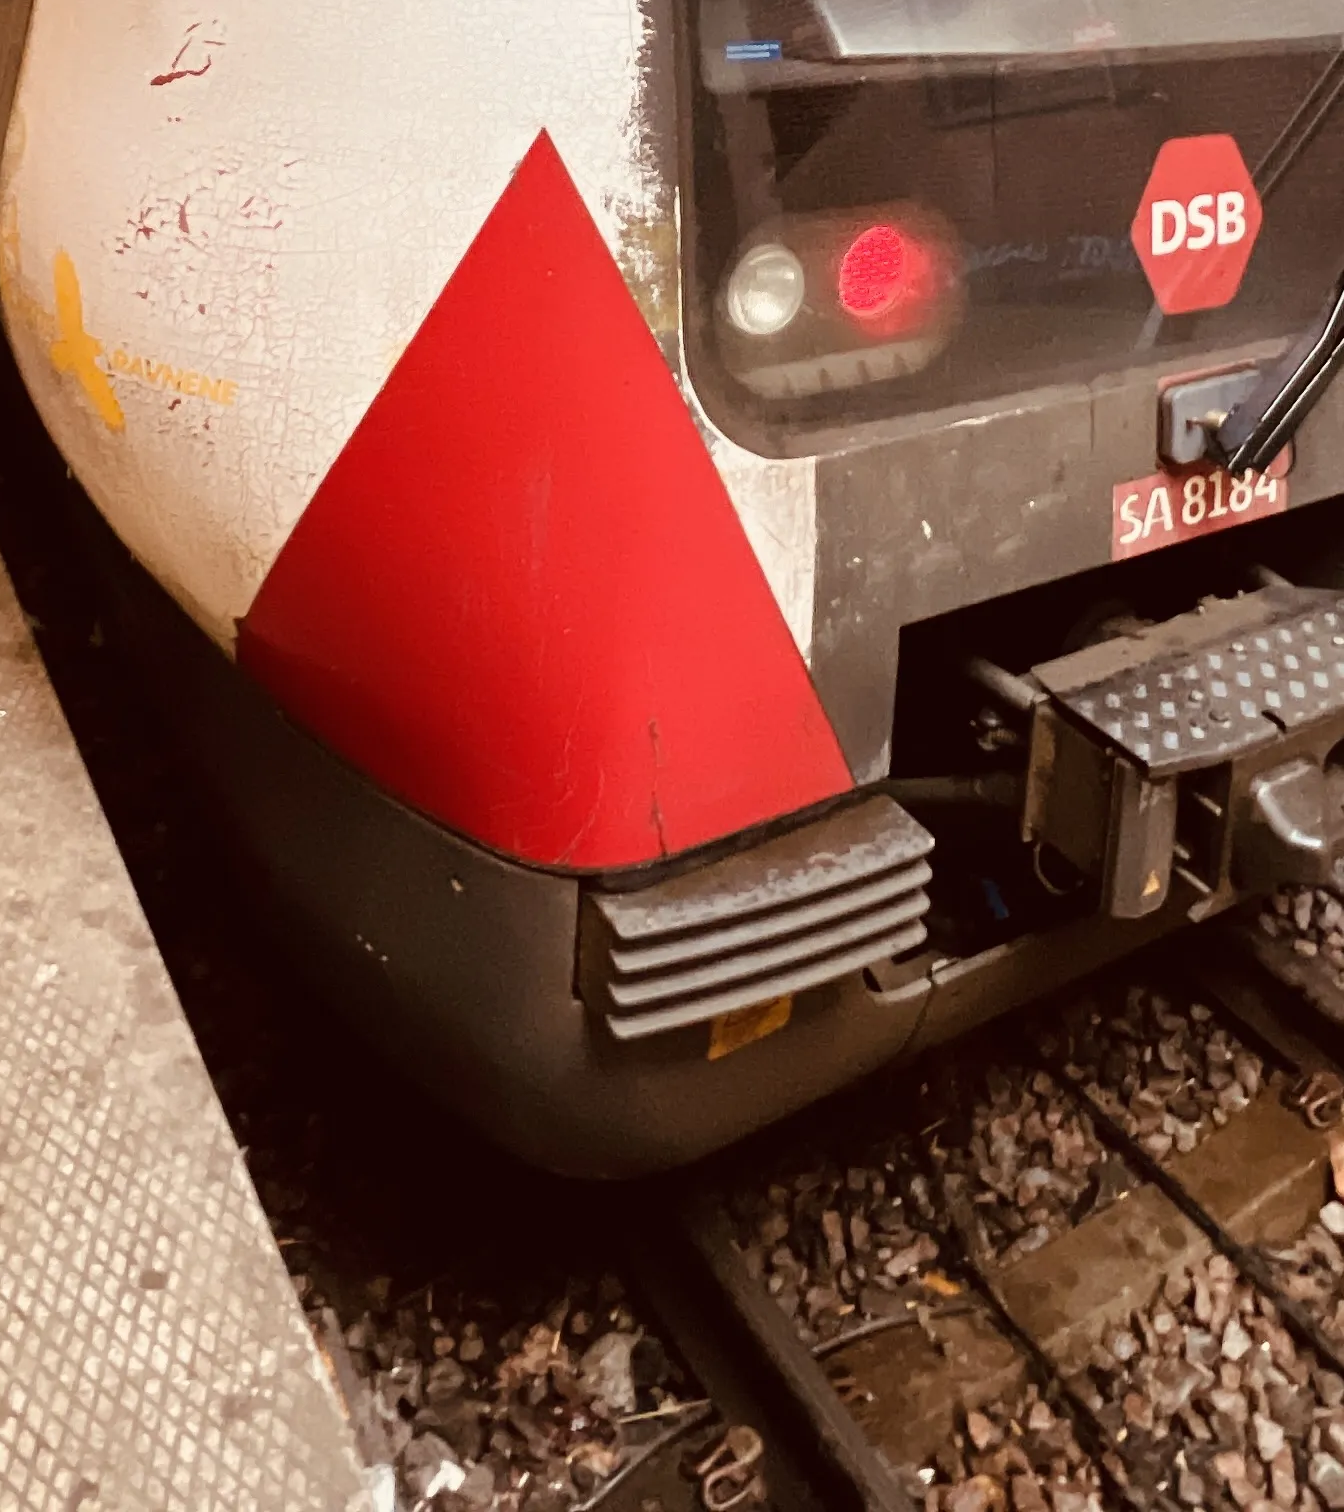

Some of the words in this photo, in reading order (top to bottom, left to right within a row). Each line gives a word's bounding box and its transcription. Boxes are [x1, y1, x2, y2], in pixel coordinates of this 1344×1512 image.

[1151, 190, 1247, 256] DSB
[1119, 486, 1174, 545] SA
[1181, 467, 1278, 525] 8184
